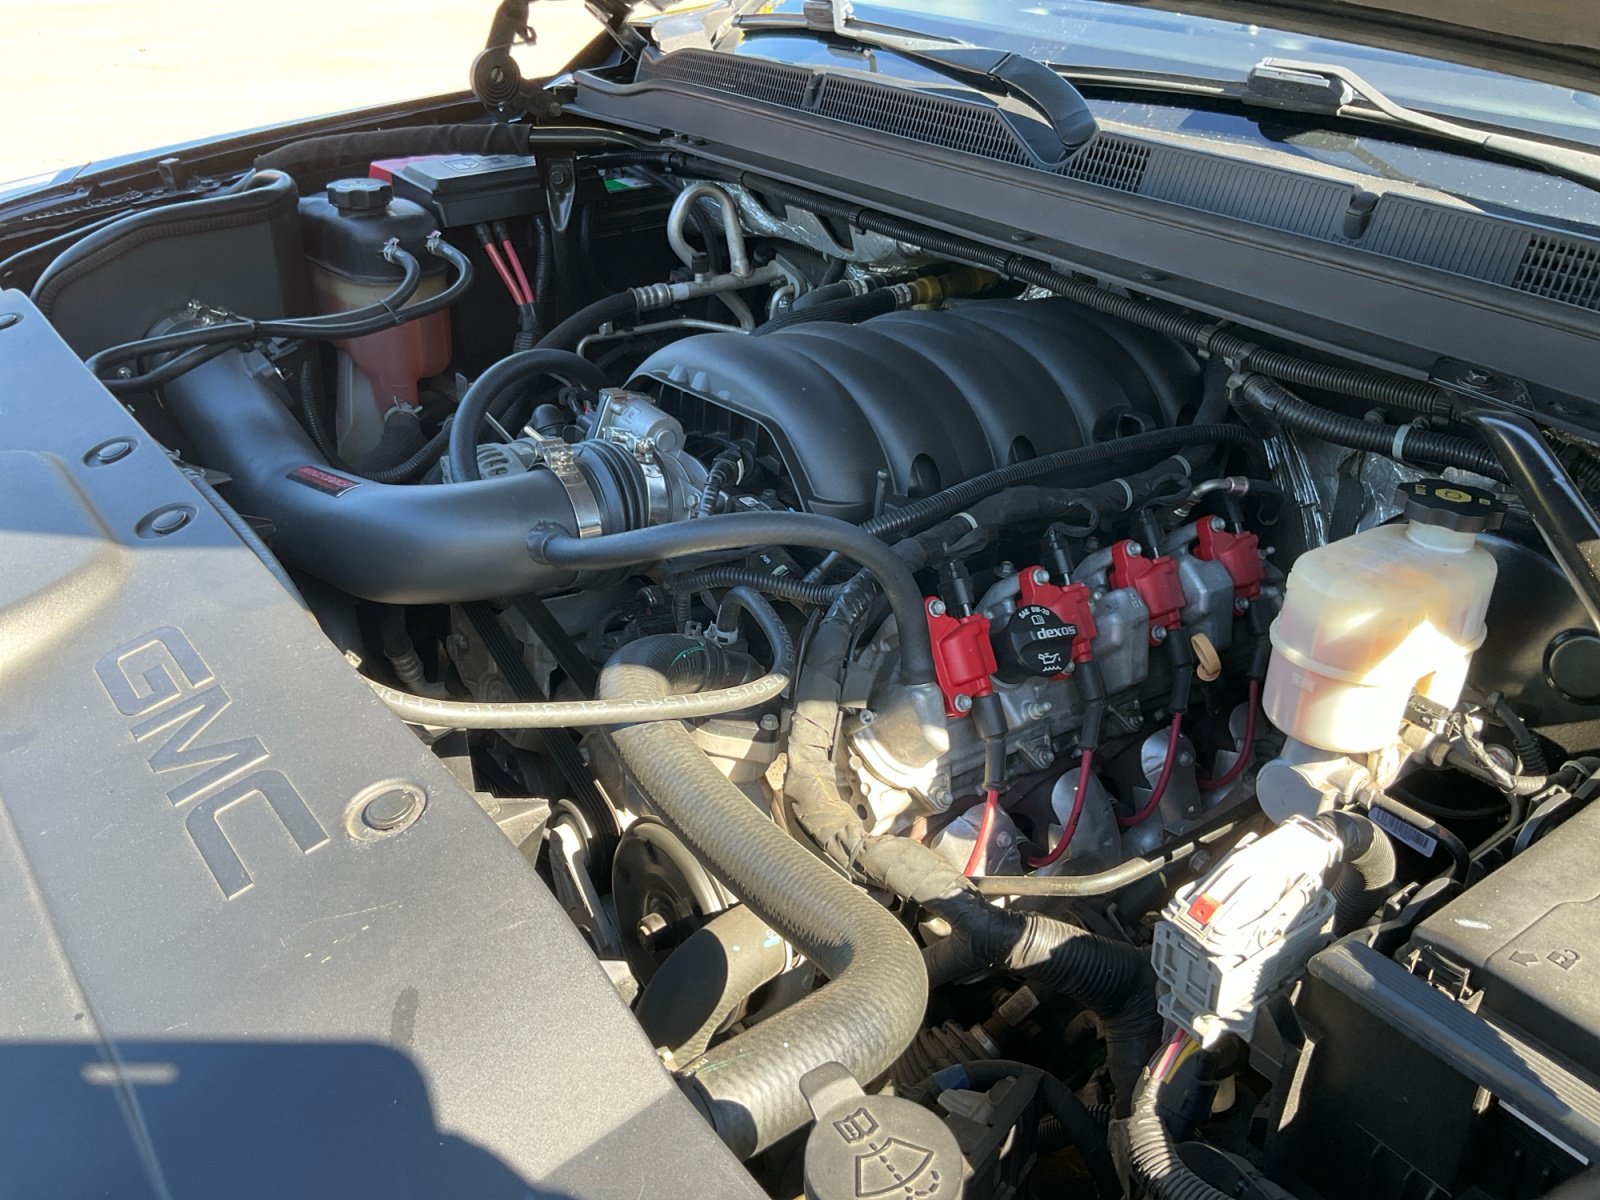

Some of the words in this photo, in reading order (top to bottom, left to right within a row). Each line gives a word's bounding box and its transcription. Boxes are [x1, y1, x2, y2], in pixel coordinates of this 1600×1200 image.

[1019, 608, 1031, 619] SAE
[1037, 625, 1077, 640] dexos
[95, 625, 331, 901] GMC
